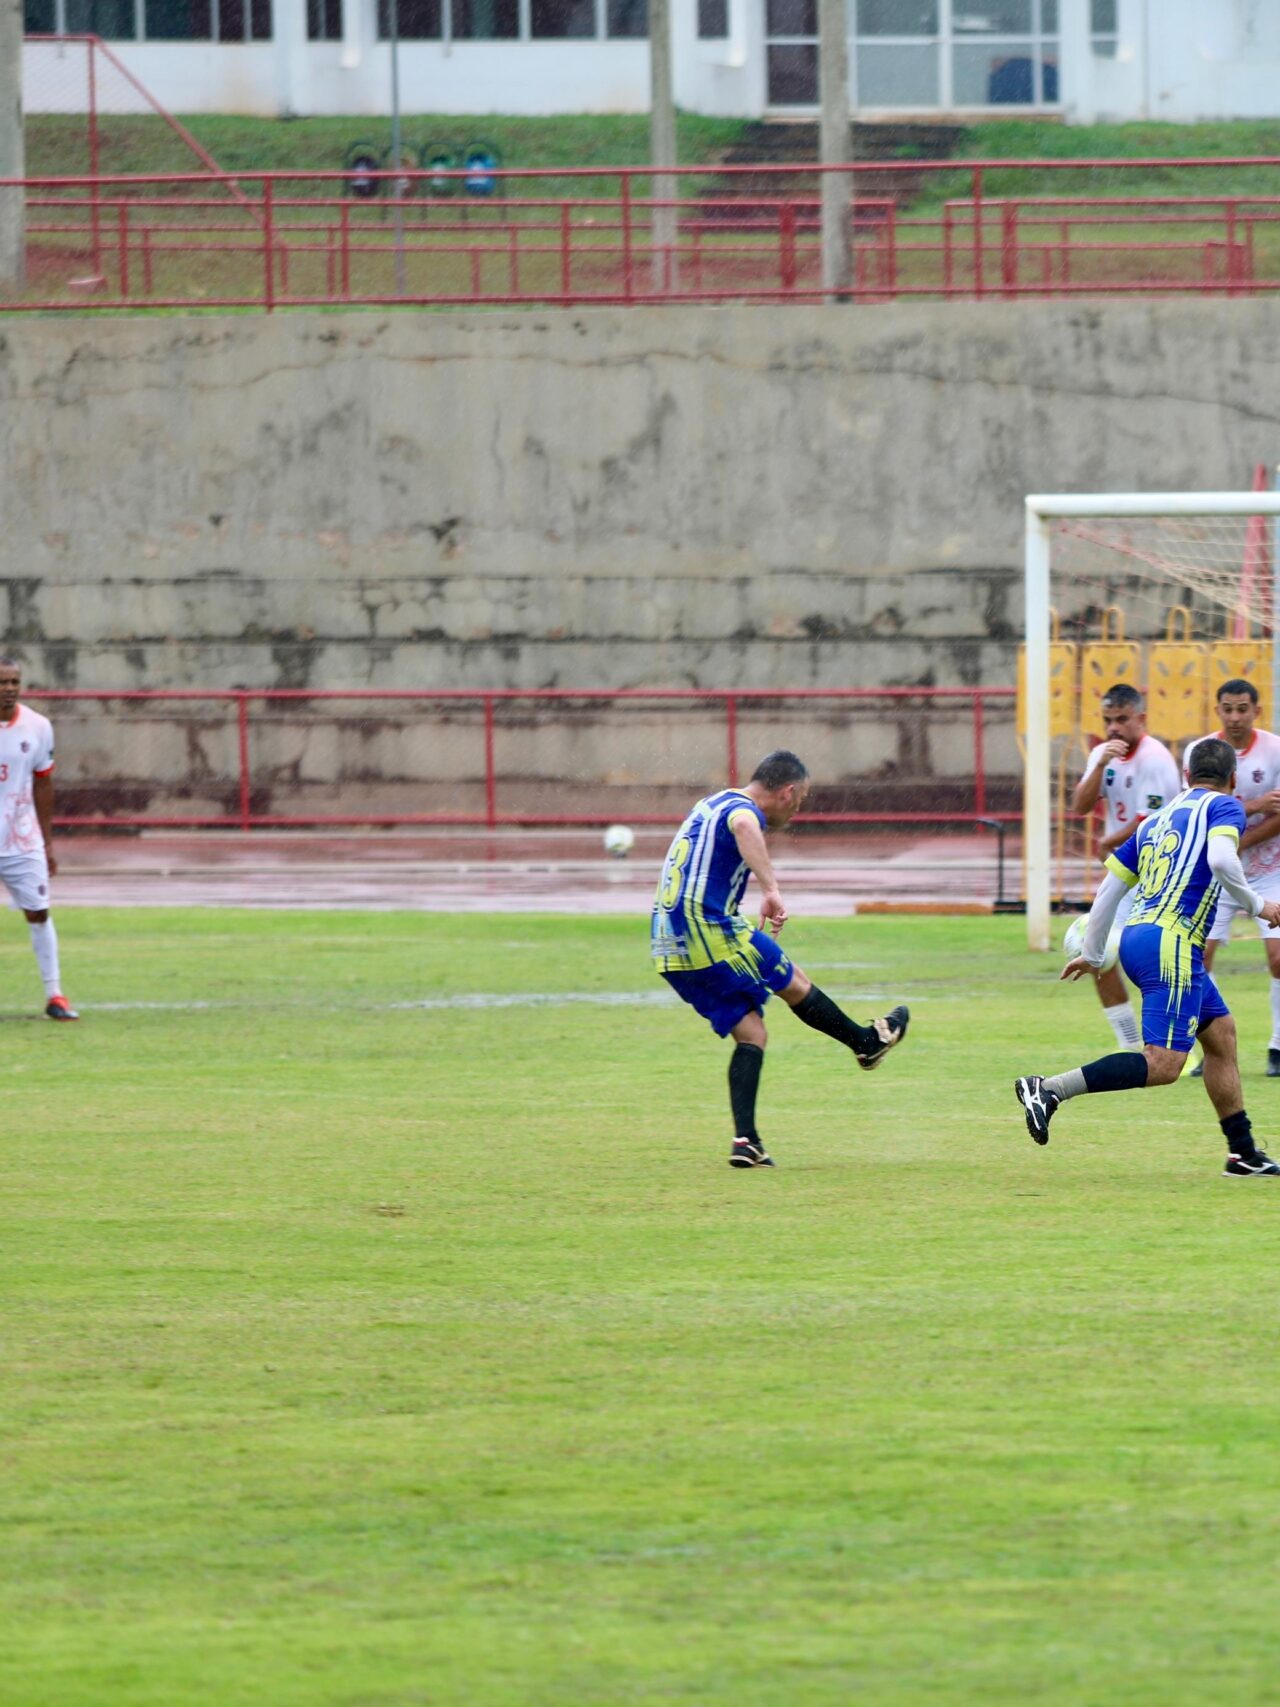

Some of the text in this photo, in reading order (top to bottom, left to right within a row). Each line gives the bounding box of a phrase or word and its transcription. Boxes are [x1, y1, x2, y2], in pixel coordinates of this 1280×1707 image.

[1116, 801, 1128, 822] 2
[653, 836, 692, 911] 3
[1187, 1015, 1198, 1037] 2
